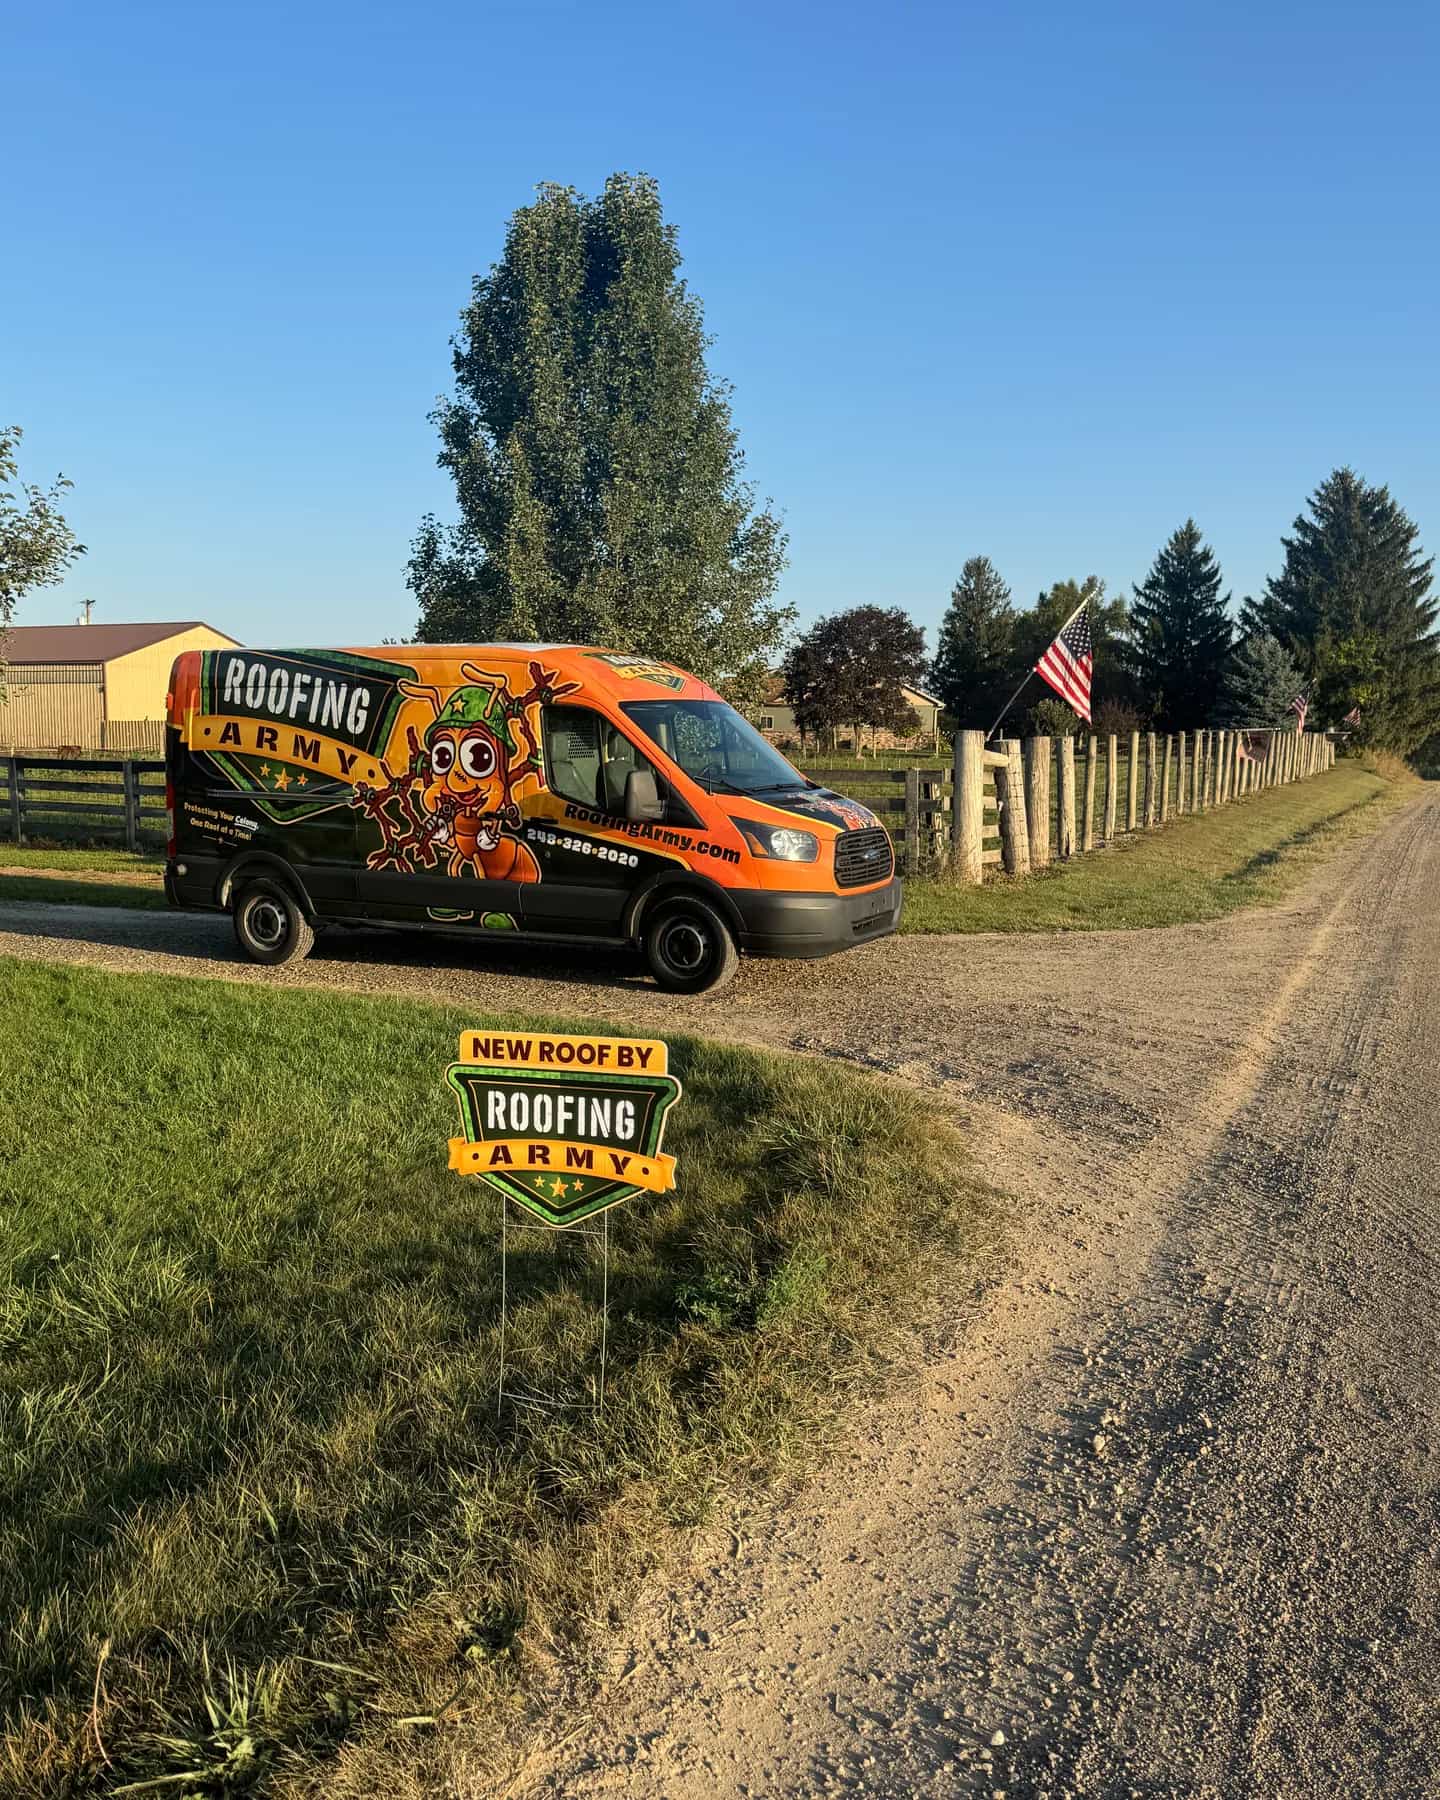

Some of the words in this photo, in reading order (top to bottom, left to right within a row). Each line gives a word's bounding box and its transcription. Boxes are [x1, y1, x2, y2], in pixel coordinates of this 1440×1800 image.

[223, 658, 370, 735] ROOFING
[219, 721, 358, 775] ARMY
[190, 817, 203, 827] One
[219, 810, 234, 821] Your
[564, 803, 740, 864] RoofingArmy.com
[472, 1037, 533, 1060] NEW
[539, 1041, 611, 1065] ROOF
[617, 1046, 653, 1068] BY
[487, 1090, 635, 1140] ROOFING
[489, 1144, 631, 1175] ARMY
